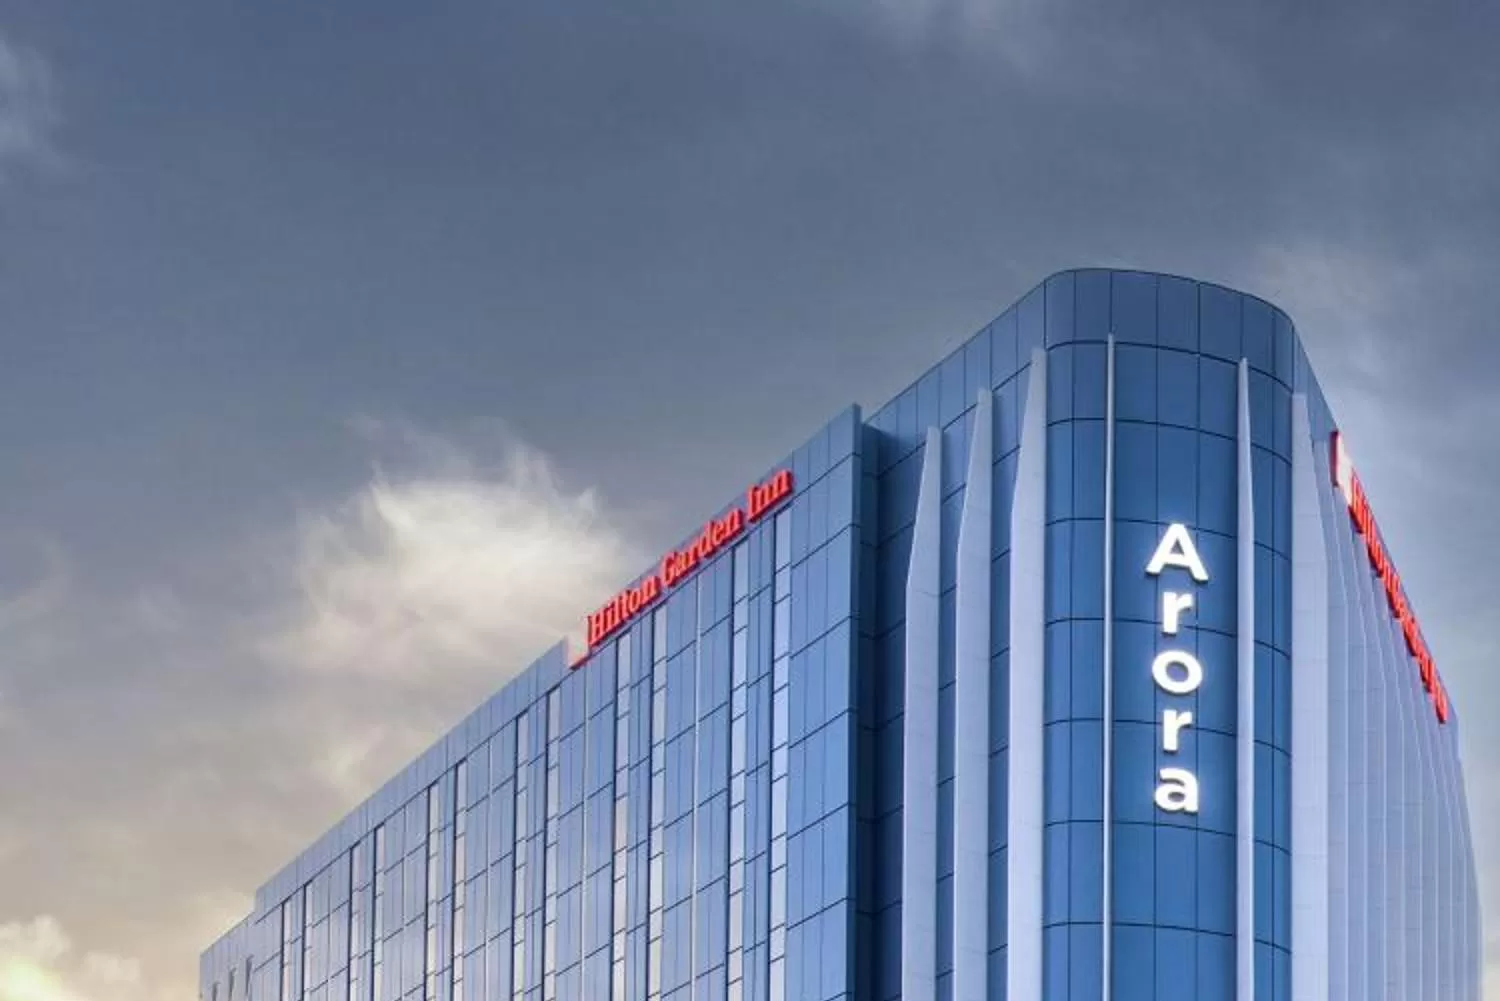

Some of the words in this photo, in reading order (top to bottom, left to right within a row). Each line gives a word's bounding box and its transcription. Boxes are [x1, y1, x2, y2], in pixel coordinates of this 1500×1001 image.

[588, 575, 661, 648] Hilton
[660, 508, 746, 588] Garden
[747, 469, 794, 523] Inn
[1145, 523, 1209, 814] Arora
